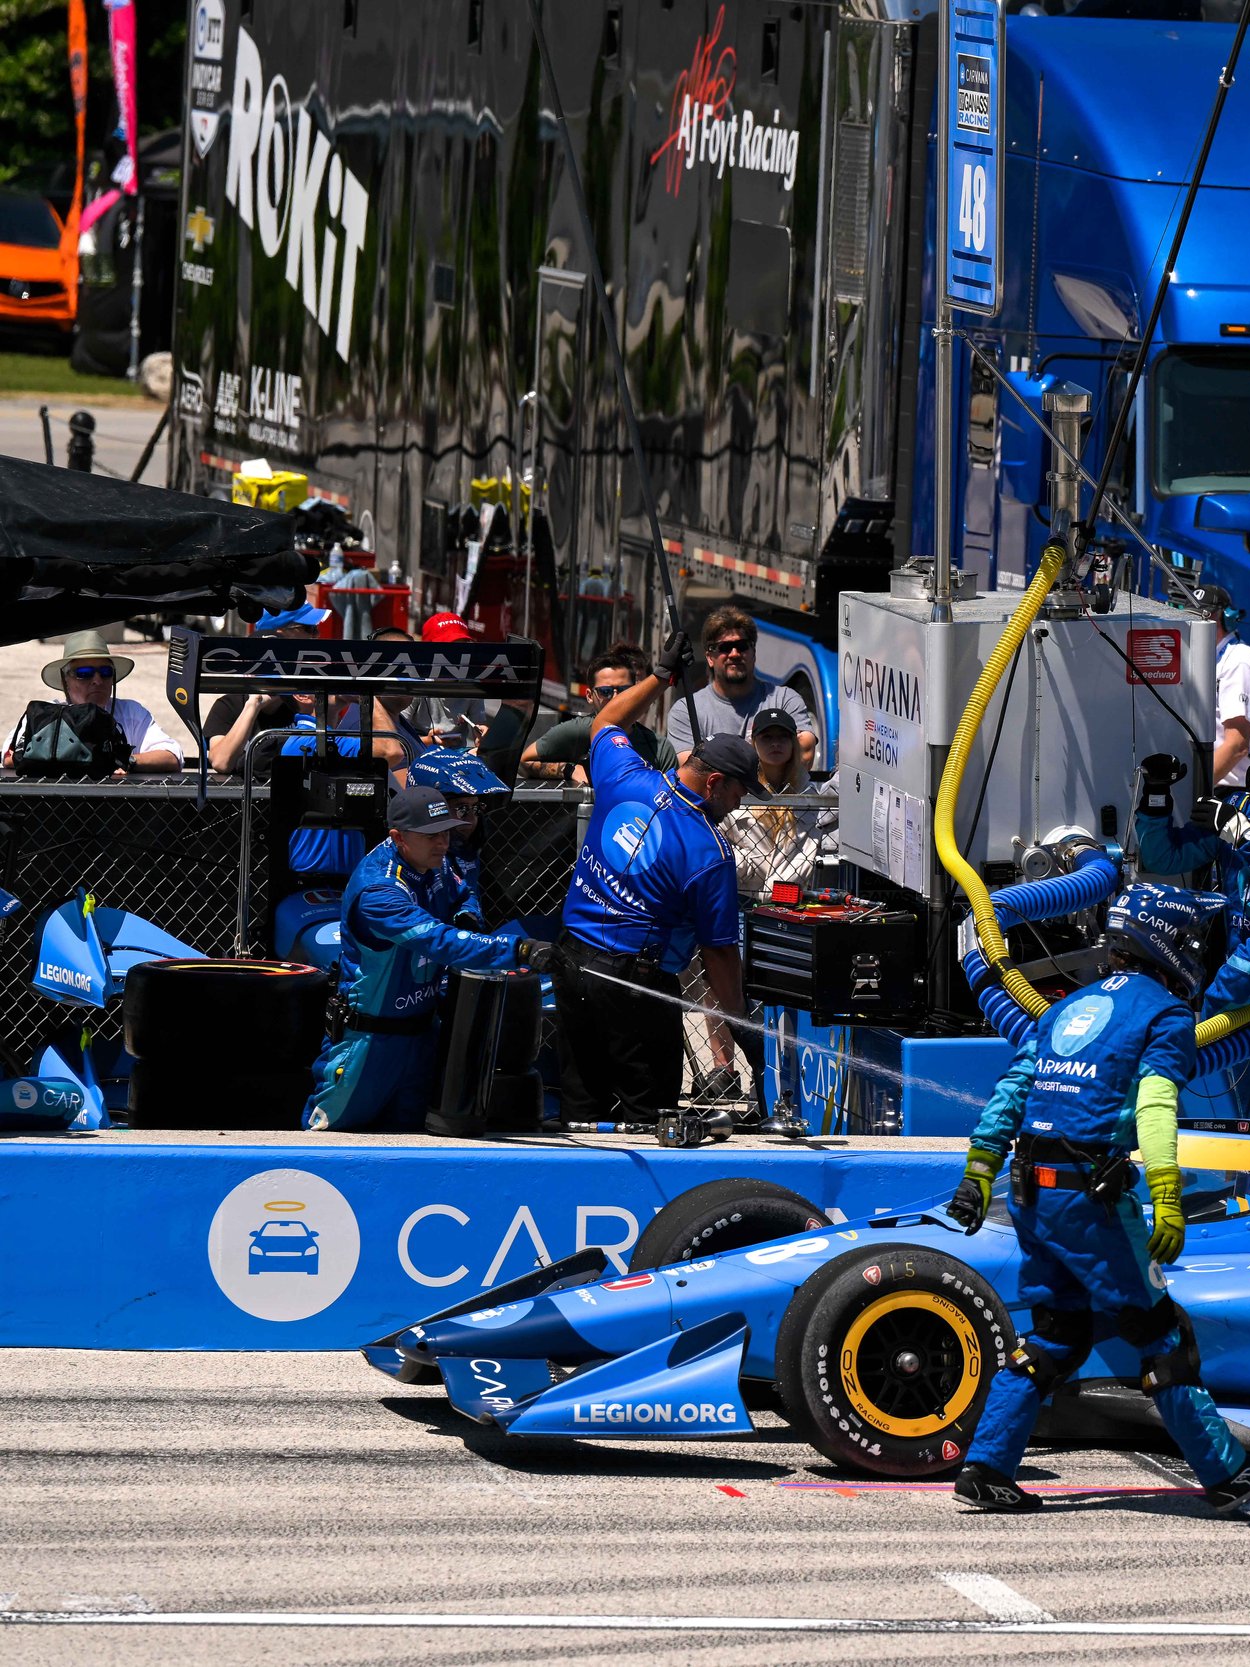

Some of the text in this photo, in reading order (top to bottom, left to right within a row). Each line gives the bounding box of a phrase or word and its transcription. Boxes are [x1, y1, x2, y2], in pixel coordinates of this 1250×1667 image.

[965, 68, 989, 85] CARVANA
[959, 111, 990, 127] RACING
[677, 93, 800, 191] AJ Foyt Racing
[958, 163, 987, 252] 48
[202, 647, 519, 681] CARVANA
[842, 650, 922, 725] CARVANA
[414, 762, 440, 775] CARVANA
[863, 734, 899, 769] LEGION
[1155, 900, 1197, 916] CARVANA
[1148, 932, 1181, 968] CARVANA
[39, 961, 92, 993] LEGION.ORG
[397, 1203, 641, 1289] CAR
[931, 1295, 967, 1325] RACING
[940, 1271, 1008, 1373] Fireston
[572, 1403, 738, 1424] LEGION.ORG
[817, 1343, 882, 1456] Firestone
[855, 1402, 891, 1432] RACING
